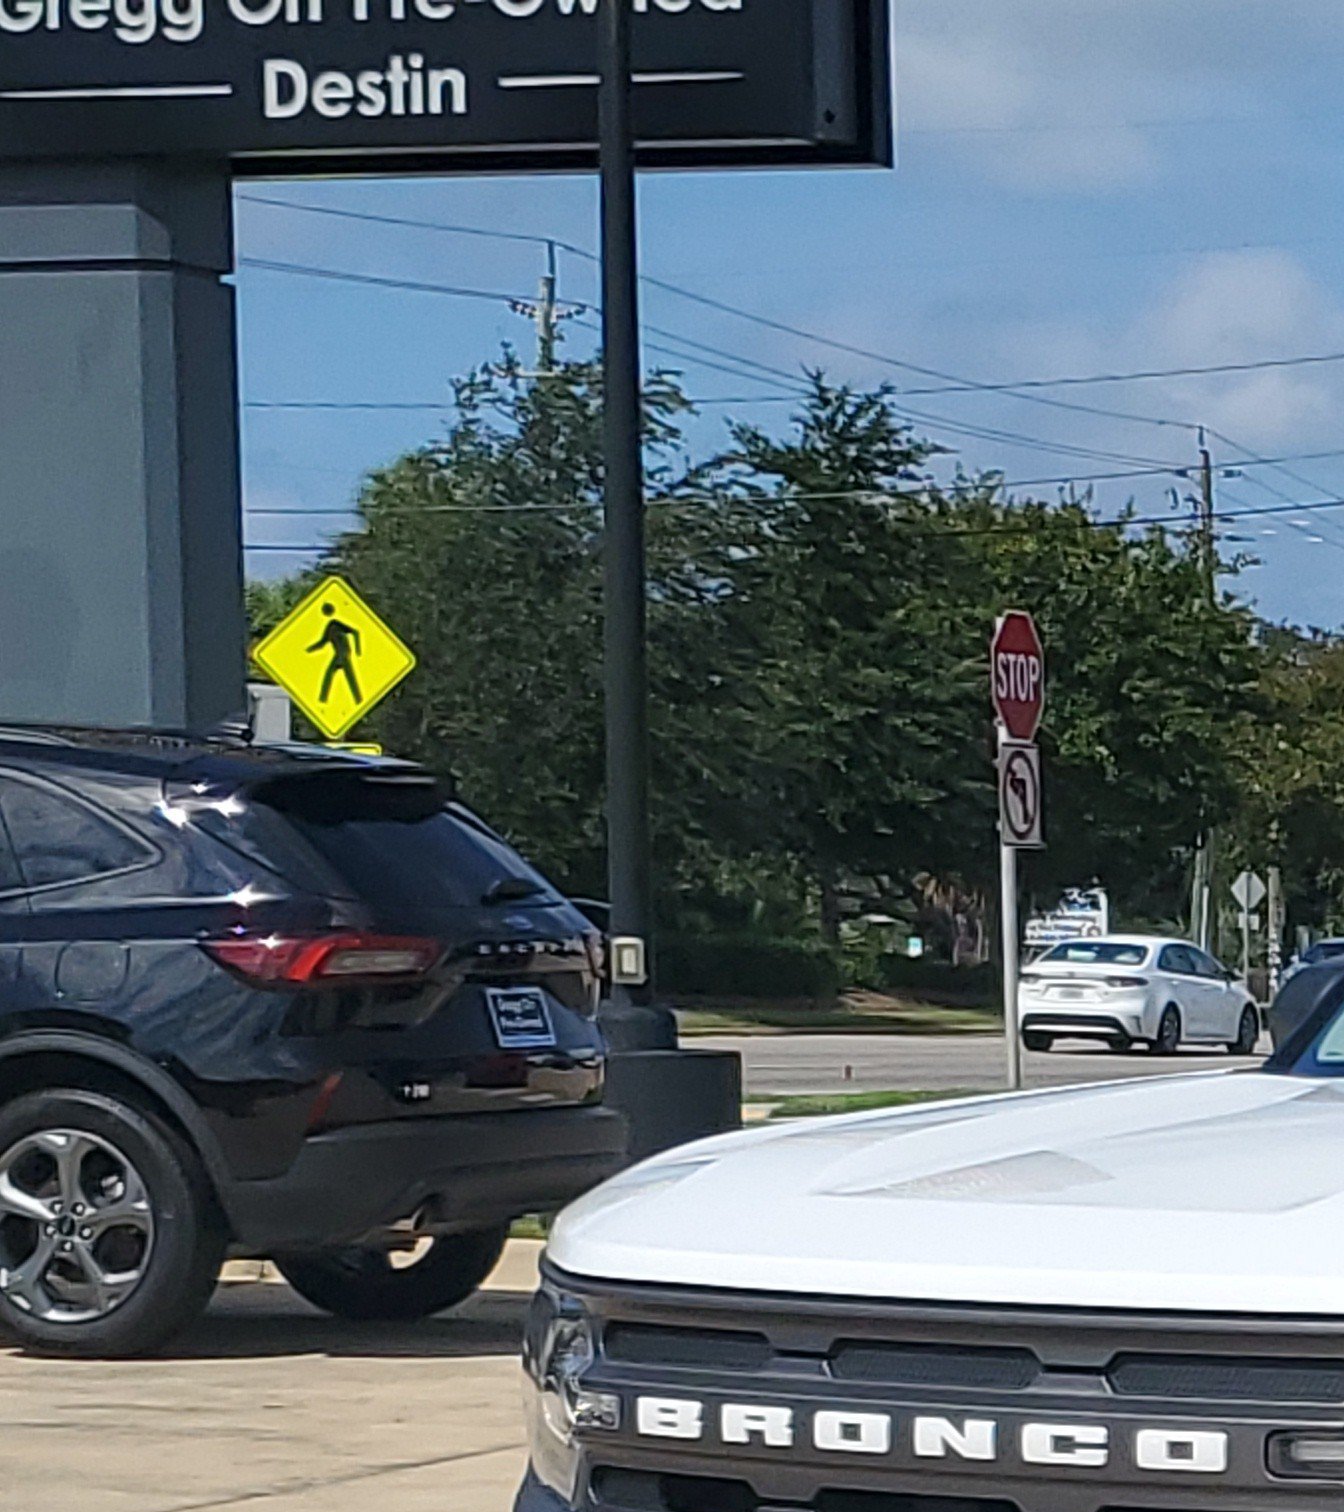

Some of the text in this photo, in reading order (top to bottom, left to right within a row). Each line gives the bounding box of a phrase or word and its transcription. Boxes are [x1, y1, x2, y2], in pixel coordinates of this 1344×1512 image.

[263, 53, 467, 119] Destin
[997, 653, 1040, 701] STOP
[636, 1395, 1229, 1473] BRONCO
